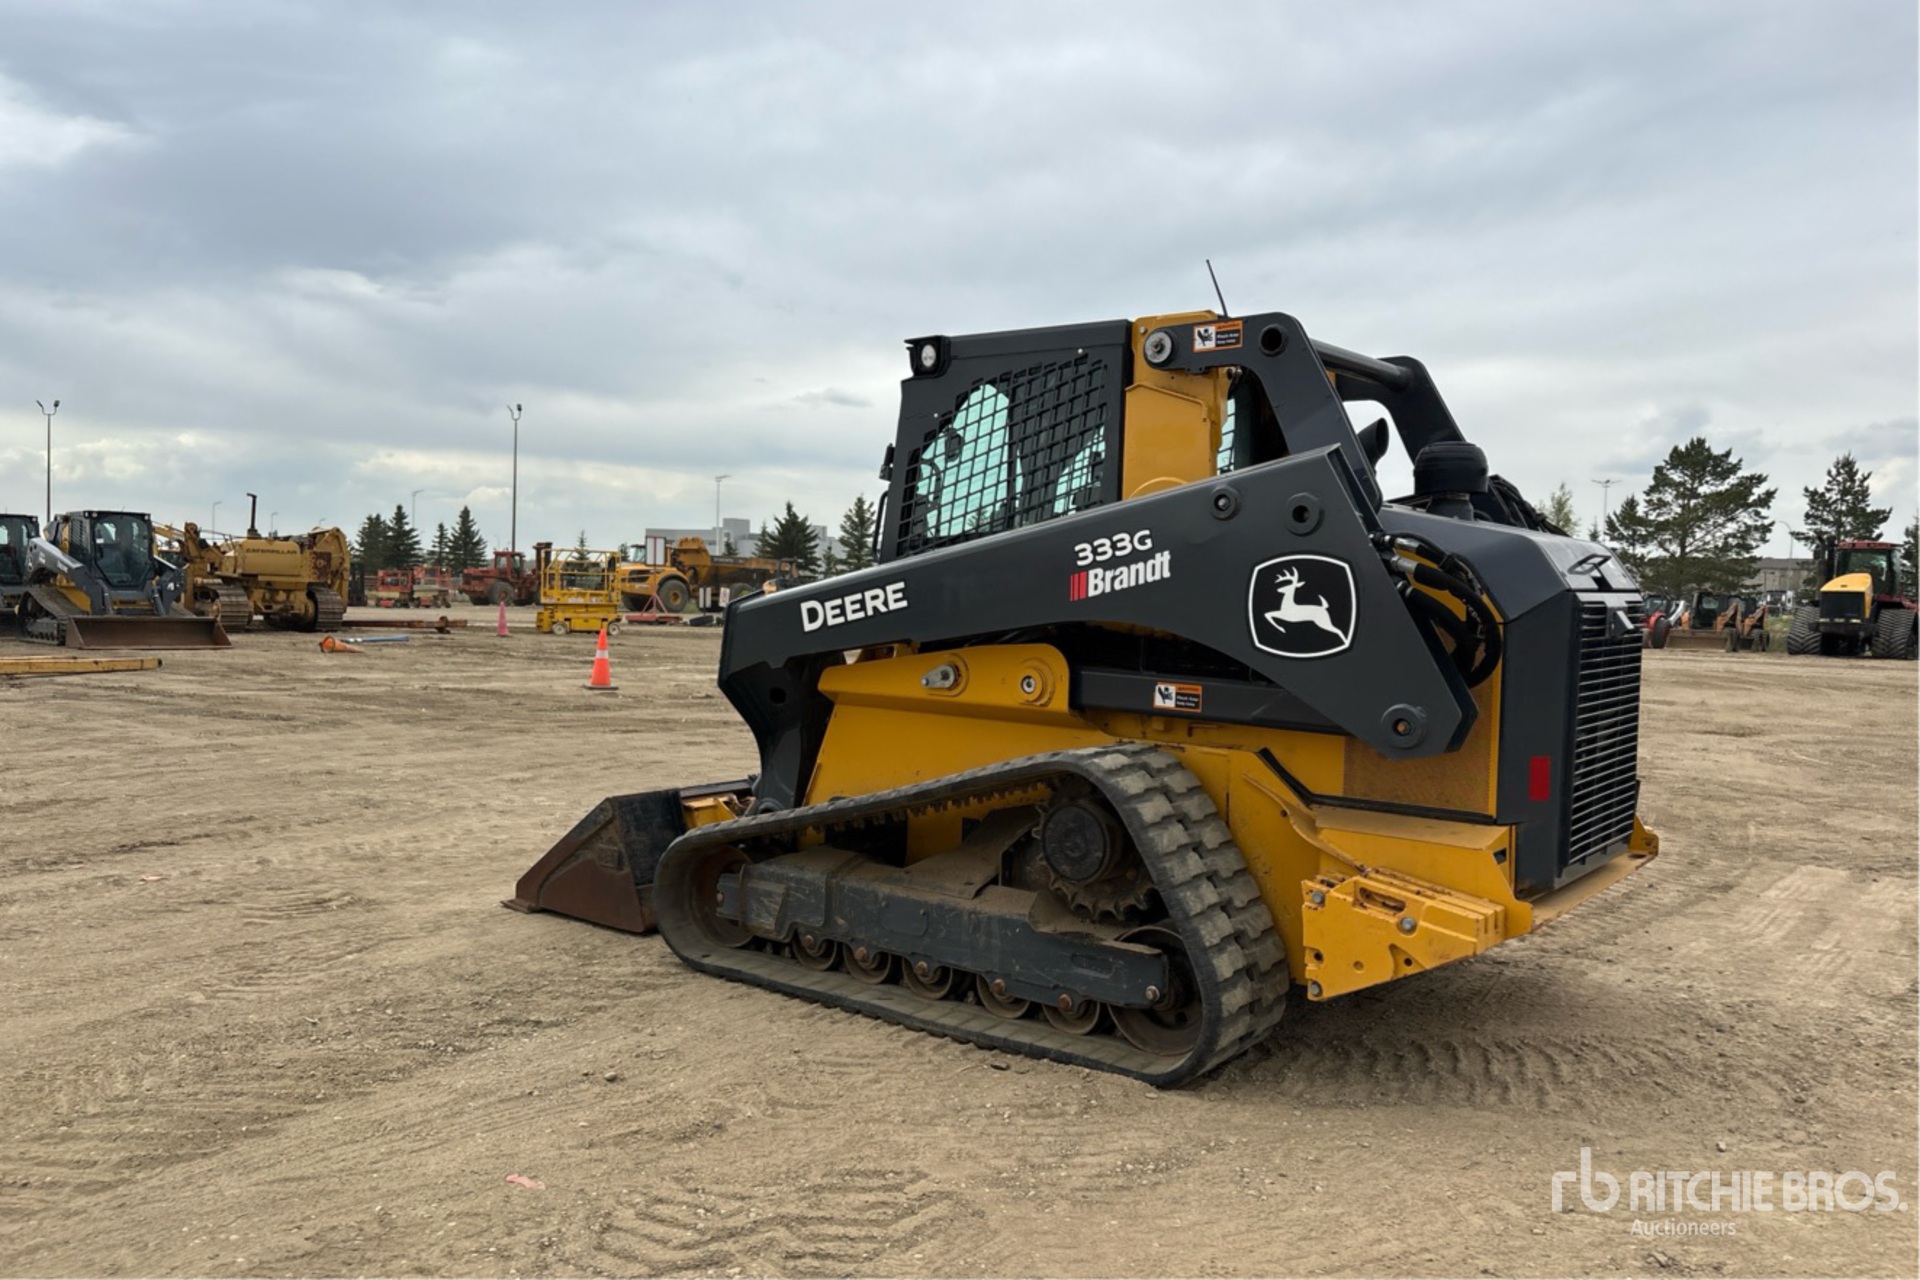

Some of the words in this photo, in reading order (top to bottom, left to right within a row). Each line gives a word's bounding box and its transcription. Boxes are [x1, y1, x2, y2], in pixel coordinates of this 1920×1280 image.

[1074, 529, 1153, 566] 333G
[1088, 550, 1171, 598] Brandt
[800, 581, 908, 632] DEERE
